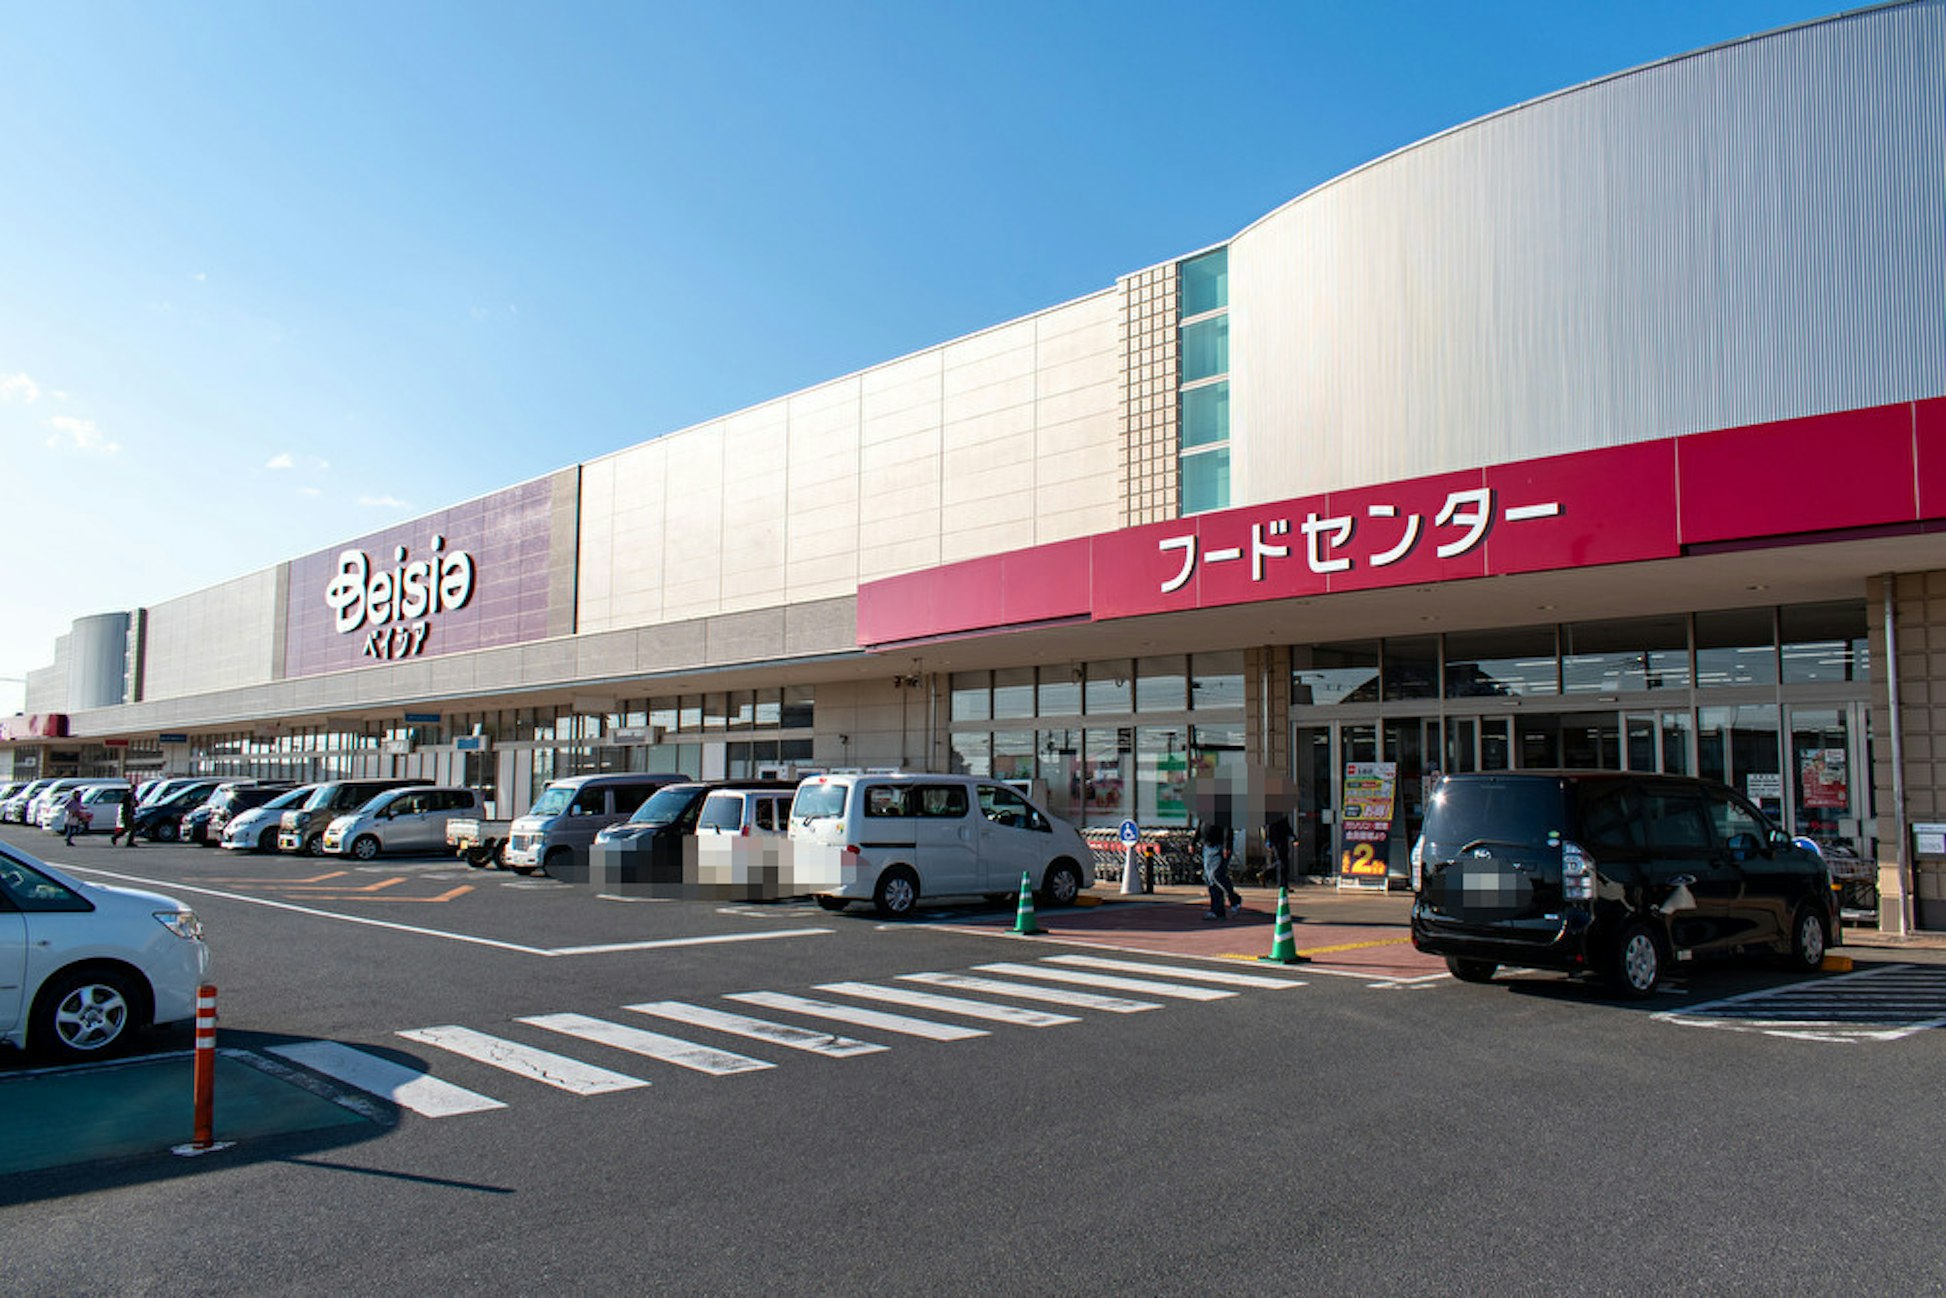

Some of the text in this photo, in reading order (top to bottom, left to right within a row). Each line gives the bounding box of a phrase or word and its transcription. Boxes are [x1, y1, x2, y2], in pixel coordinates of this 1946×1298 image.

[326, 534, 475, 634] Beisia
[1158, 487, 1563, 594] フードセンター
[363, 620, 430, 659] ベイシア
